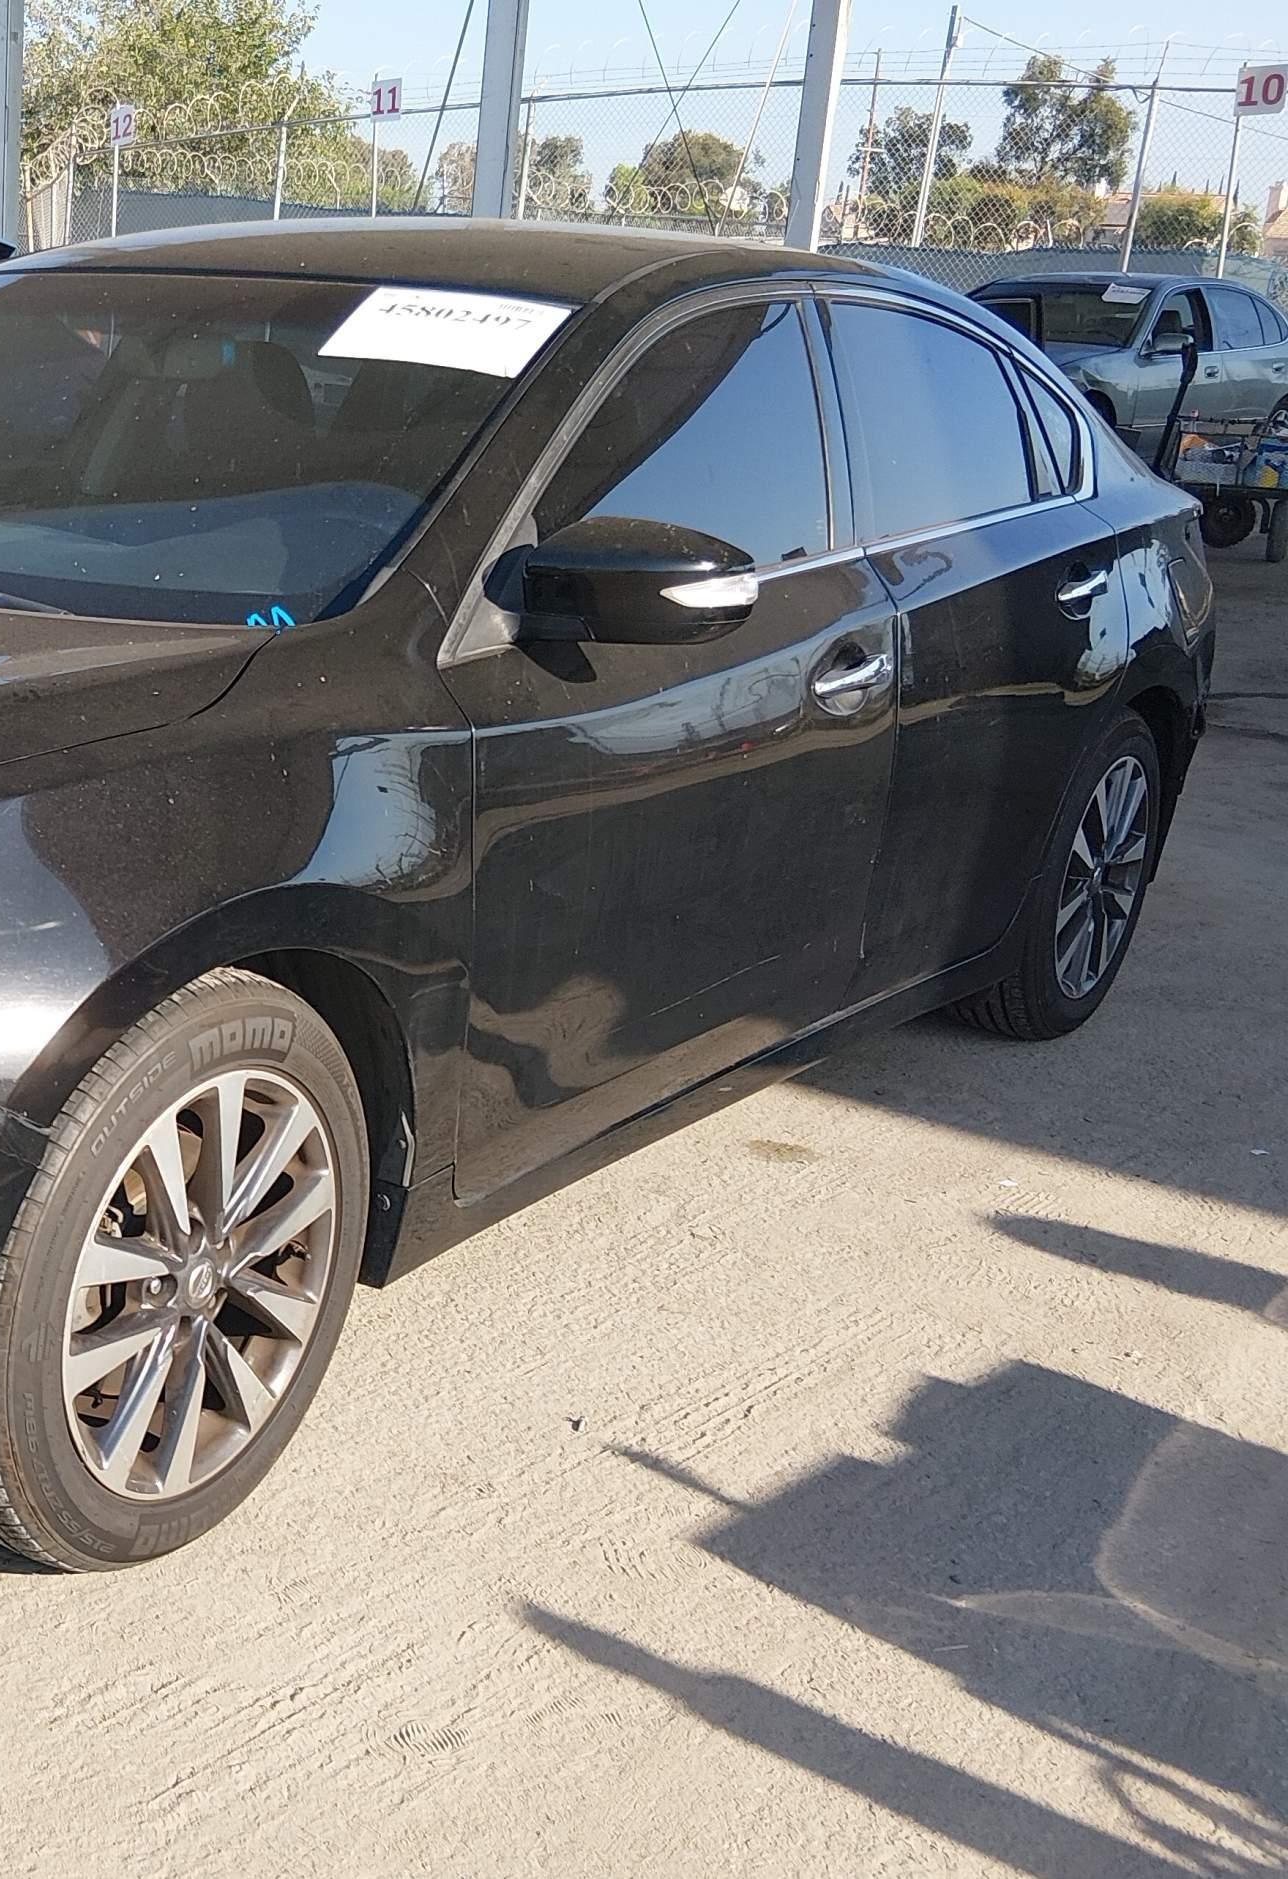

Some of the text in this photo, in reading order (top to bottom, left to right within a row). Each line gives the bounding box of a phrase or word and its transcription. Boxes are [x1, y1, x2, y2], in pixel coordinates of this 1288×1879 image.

[372, 86, 400, 115] 11
[1238, 73, 1285, 107] 10
[112, 113, 132, 140] 12
[378, 303, 533, 330] 45802497
[90, 1050, 178, 1159] OUTSIDE
